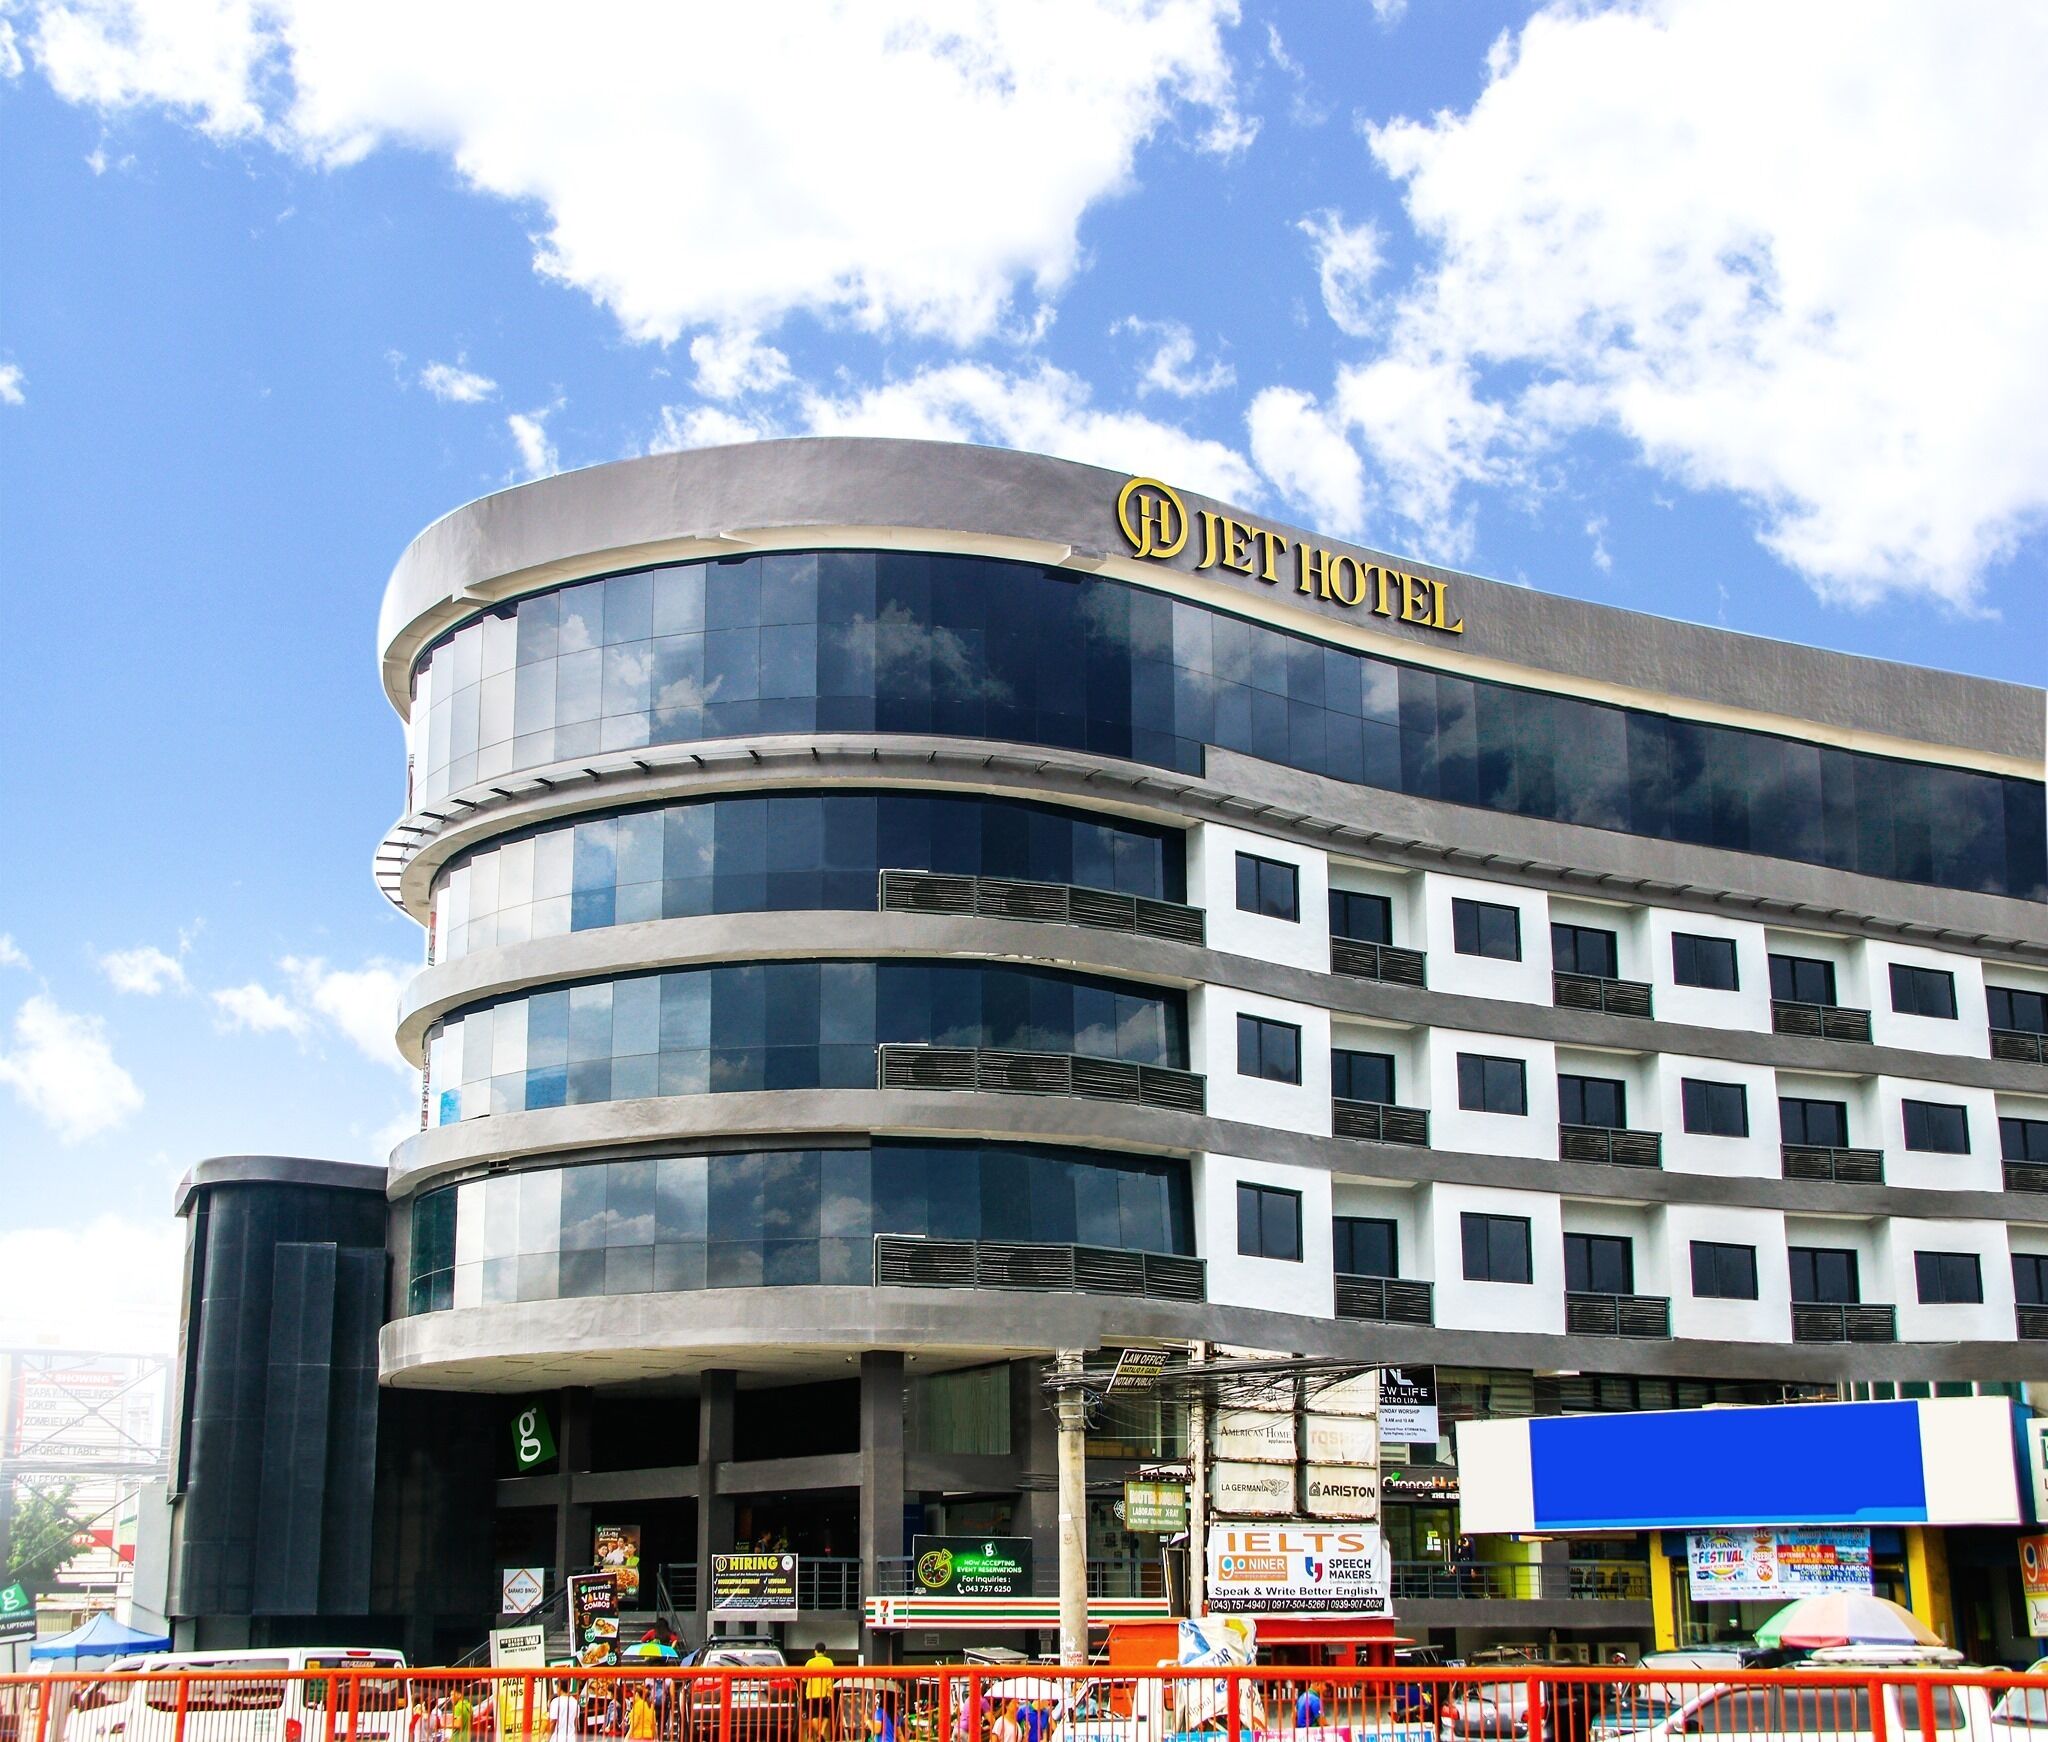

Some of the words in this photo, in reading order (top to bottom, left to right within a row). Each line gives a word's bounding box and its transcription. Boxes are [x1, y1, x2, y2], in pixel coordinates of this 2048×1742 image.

[1198, 510, 1287, 584] JET
[1297, 542, 1464, 635] HOTEL
[1123, 1353, 1141, 1364] LAW
[1140, 1354, 1166, 1365] OFFICE
[1113, 1377, 1135, 1386] NOTARY
[1133, 1377, 1154, 1386] PUBLIC
[1400, 1387, 1428, 1397] LIFE
[26, 1400, 57, 1410] JOKER
[519, 1407, 542, 1463] g
[1220, 1425, 1264, 1438] AMERICAN
[1266, 1427, 1292, 1439] HOME
[1221, 1483, 1231, 1491] LA
[1231, 1484, 1269, 1493] GERMANIA
[1322, 1485, 1375, 1498] ARISTON
[1132, 1506, 1162, 1517] LABORATORY
[1165, 1508, 1179, 1517] X-RAY
[1227, 1532, 1365, 1553] IELTS
[1700, 1541, 1742, 1550] APPLIANCE
[1698, 1549, 1744, 1563] FESTIVAL
[729, 1556, 778, 1571] HIRING
[1248, 1558, 1286, 1571] NINER
[1329, 1558, 1371, 1569] SPEECH
[1329, 1570, 1372, 1579] MAKERS
[587, 1584, 612, 1592] greenwich
[1215, 1587, 1250, 1597] Speak
[1253, 1587, 1262, 1596] &
[1266, 1587, 1296, 1596] Write
[1300, 1587, 1332, 1596] Better
[1336, 1586, 1378, 1597] English
[581, 1592, 611, 1604] VALUE
[583, 1601, 610, 1611] COMBOS
[1211, 1600, 1231, 1611] (043)
[1231, 1600, 1266, 1609] 757-4940
[1271, 1600, 1326, 1609] 0917-504-5266
[7, 1620, 36, 1630] UPTOWN
